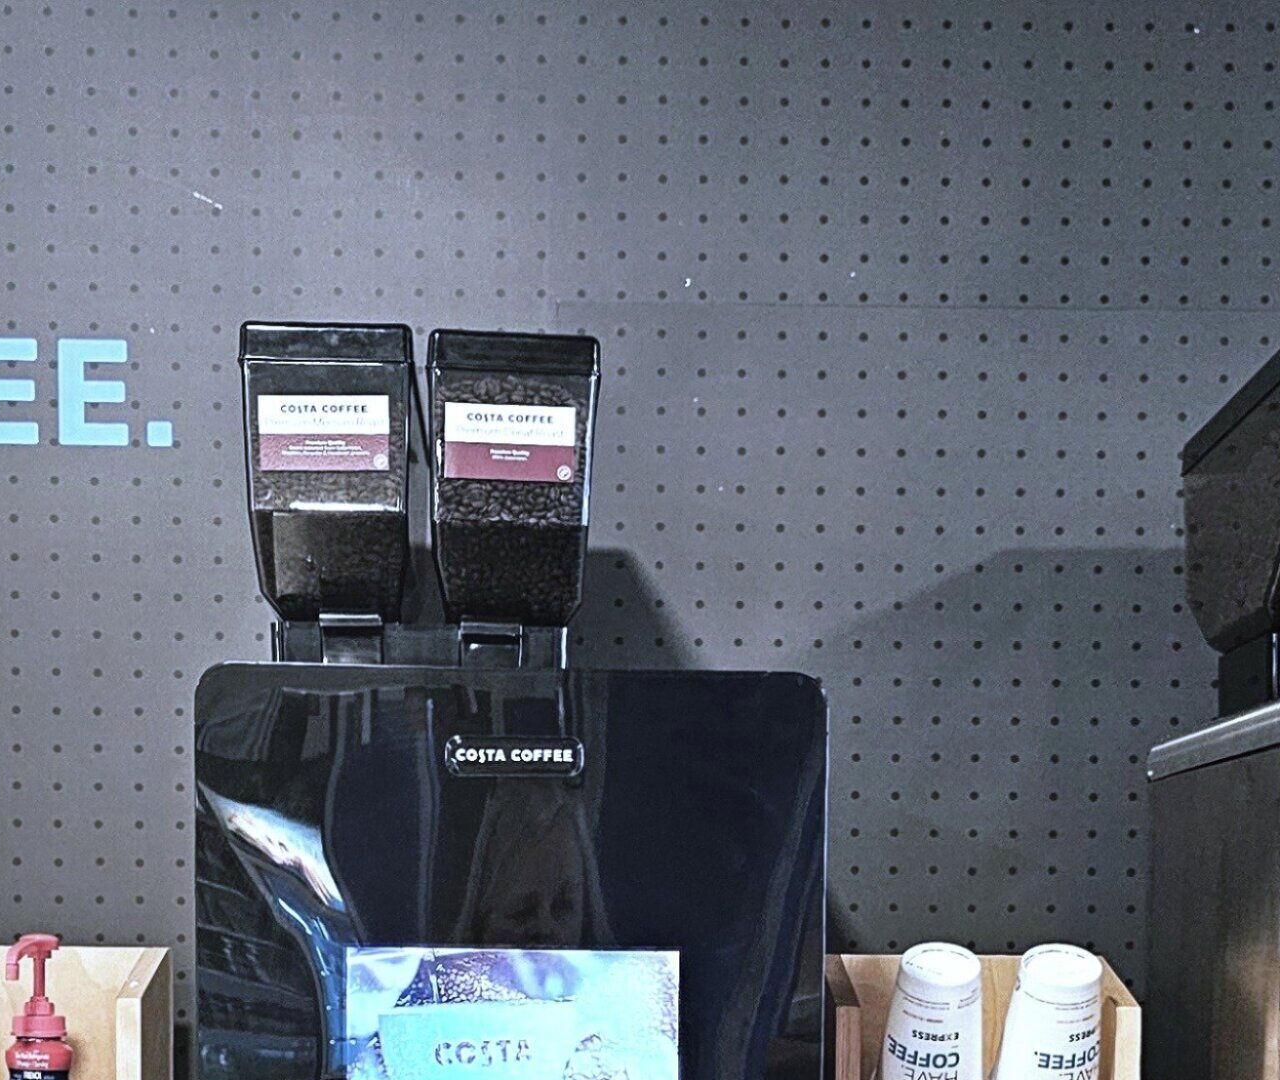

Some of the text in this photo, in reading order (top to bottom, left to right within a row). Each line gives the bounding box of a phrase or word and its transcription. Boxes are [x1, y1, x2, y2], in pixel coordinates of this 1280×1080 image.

[280, 404, 368, 414] COSTA COFFEE
[467, 412, 553, 425] COSTA COFFEE
[455, 748, 574, 764] COSTA COFFEE
[911, 1029, 960, 1042] EXPRESS
[1068, 1027, 1096, 1042] PRESS
[434, 1039, 532, 1068] COSTA
[887, 1033, 960, 1069] COFFEE.
